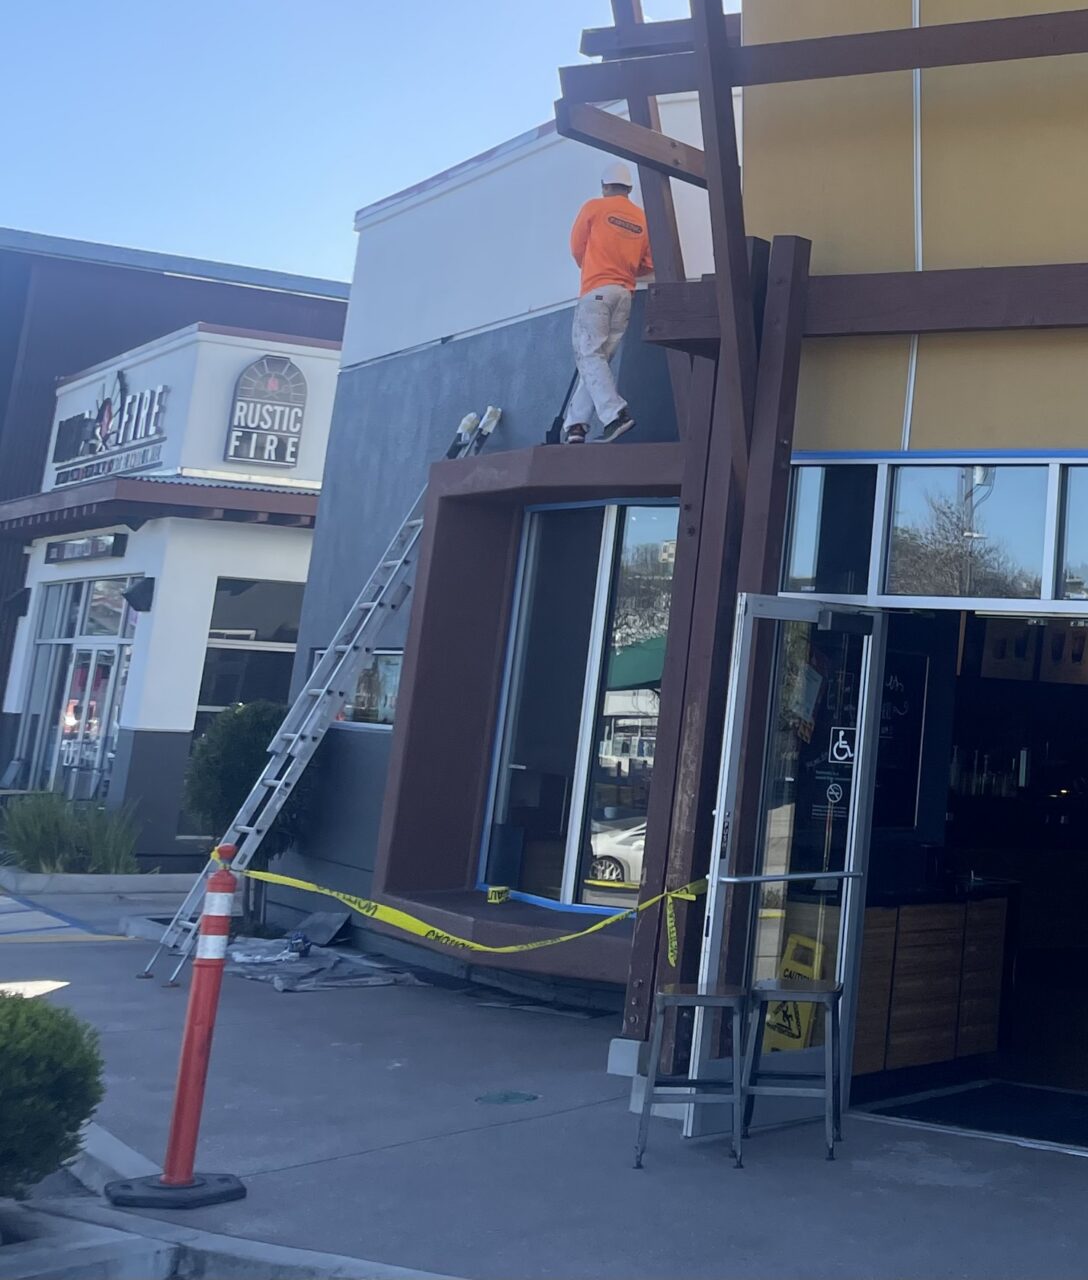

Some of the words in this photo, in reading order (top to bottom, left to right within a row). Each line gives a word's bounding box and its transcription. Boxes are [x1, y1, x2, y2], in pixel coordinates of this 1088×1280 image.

[117, 385, 164, 443] FIRE
[233, 401, 303, 432] RUSTIC
[228, 431, 298, 463] FIRE
